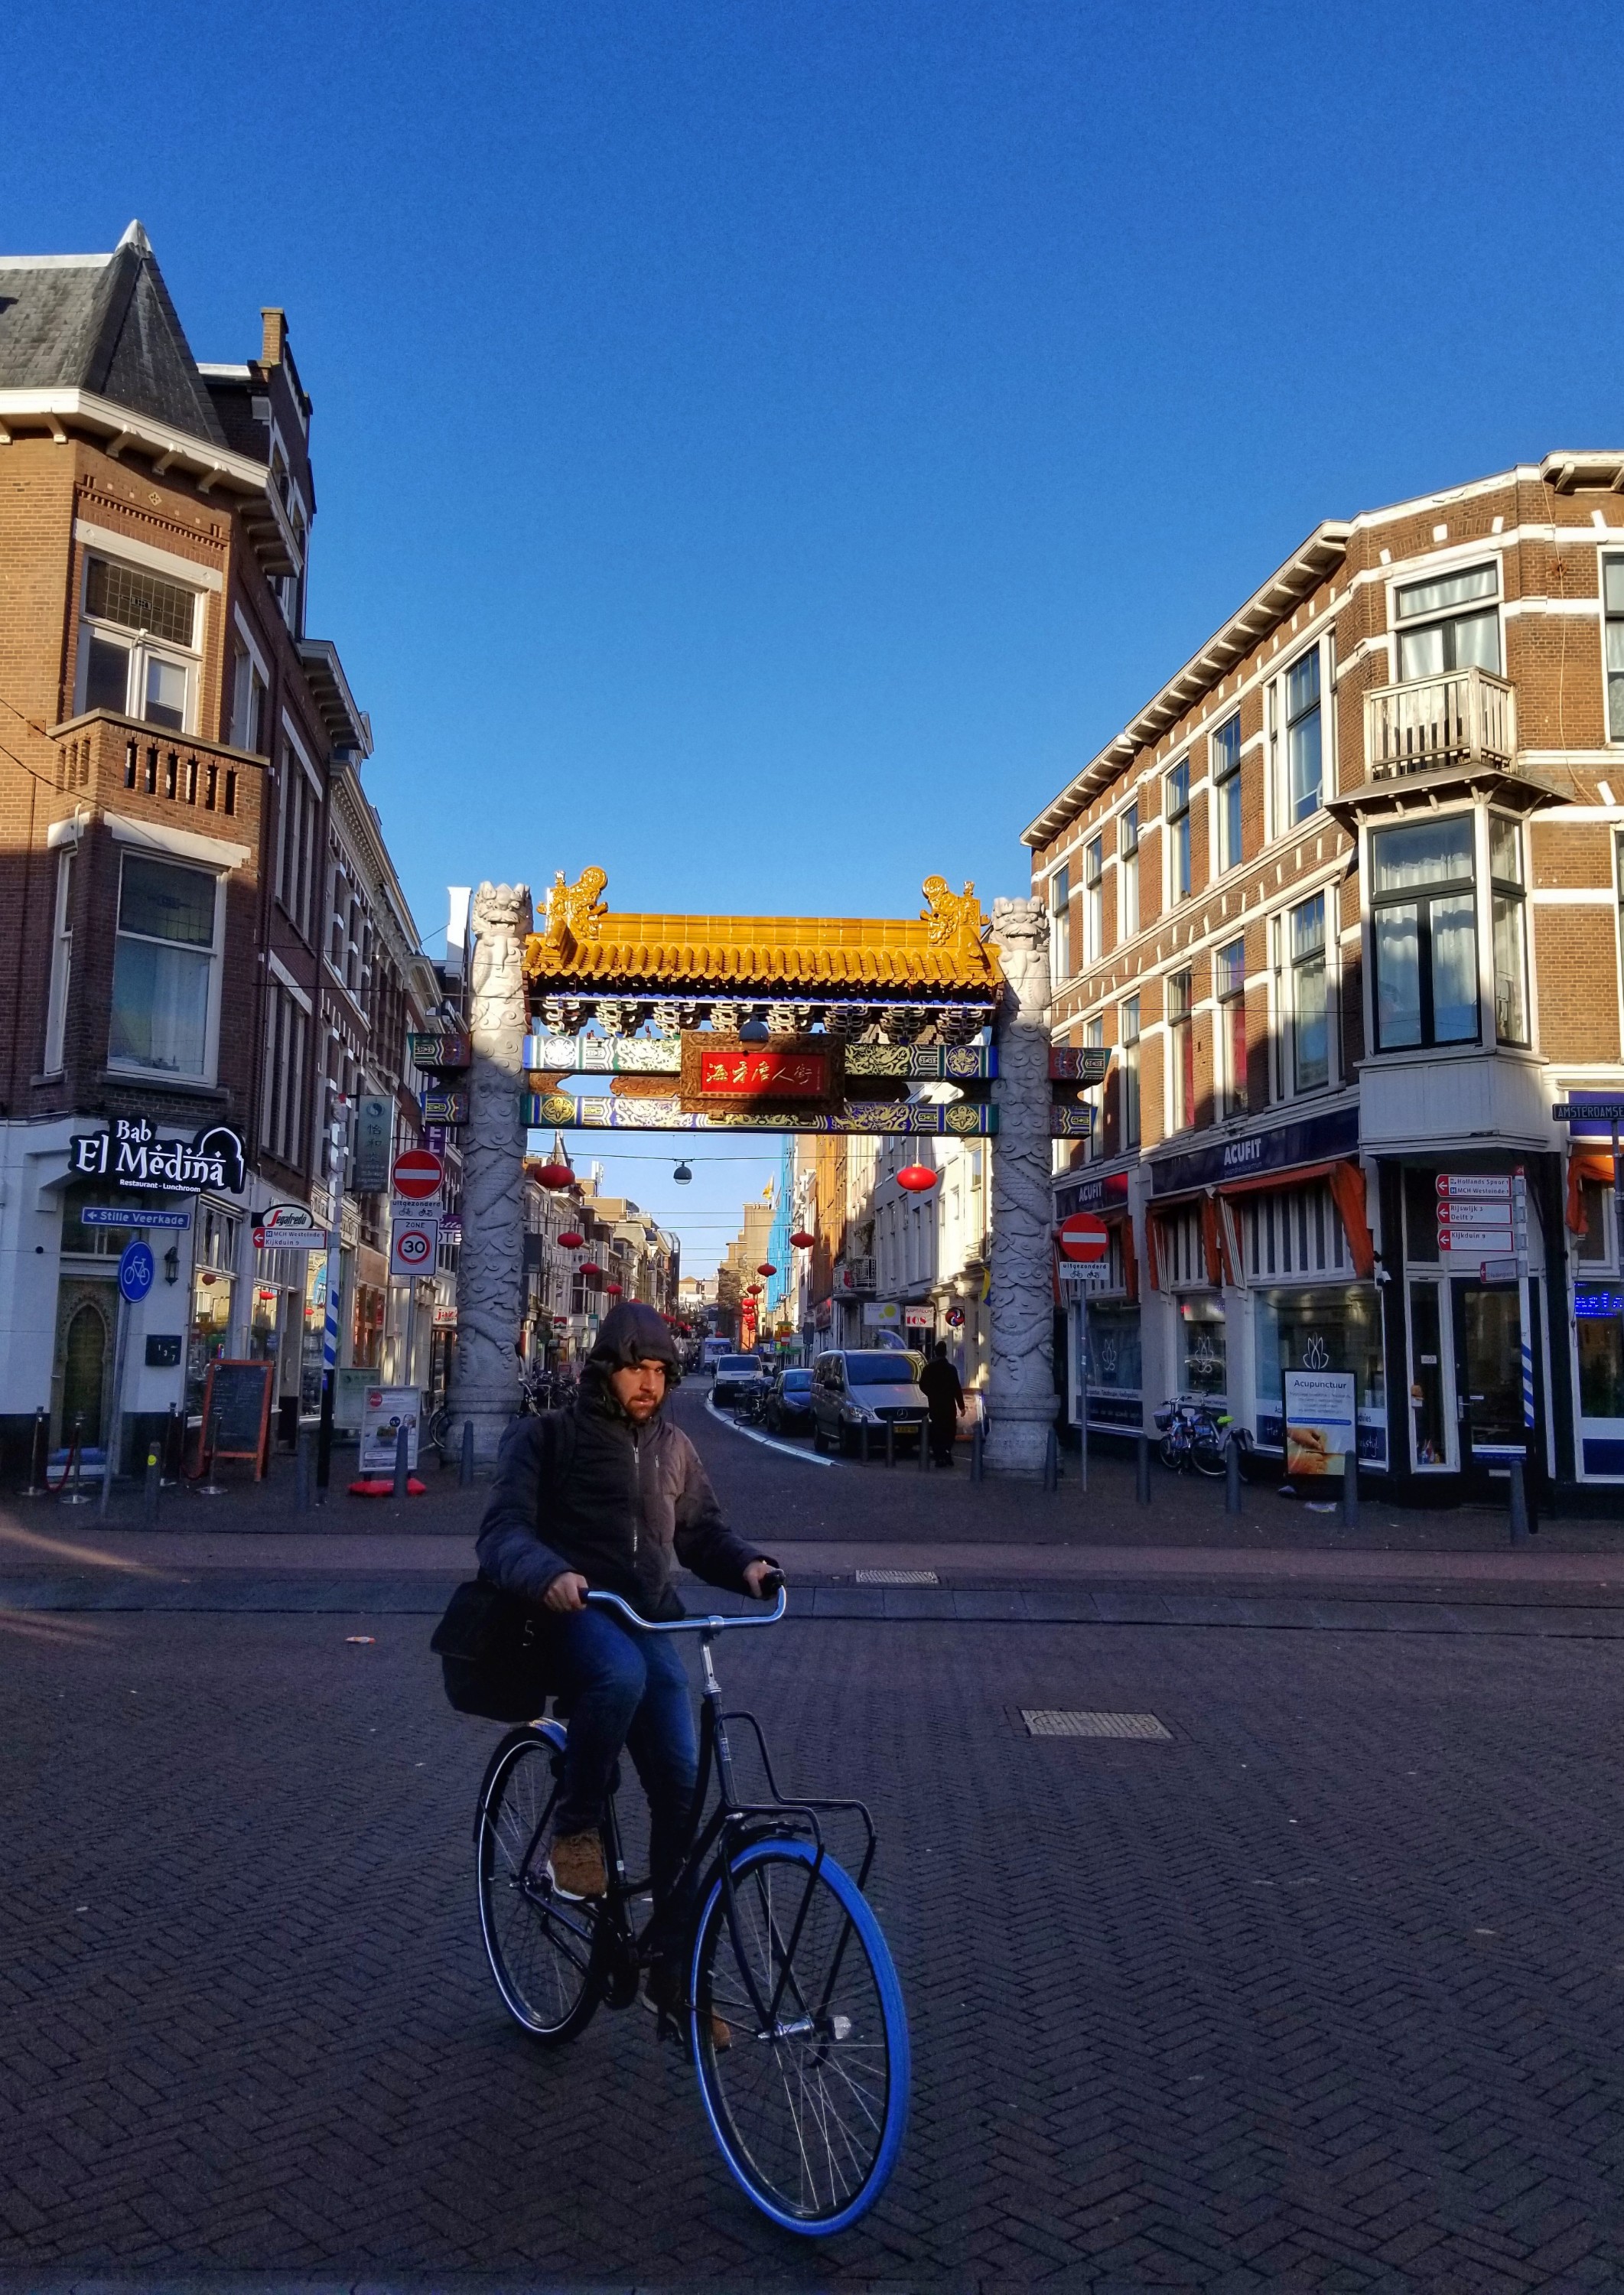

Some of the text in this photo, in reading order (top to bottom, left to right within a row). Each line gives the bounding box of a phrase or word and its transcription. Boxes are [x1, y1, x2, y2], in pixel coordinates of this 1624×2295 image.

[116, 1119, 151, 1143] Bab
[76, 1134, 109, 1174] El
[1224, 1138, 1261, 1166] ACUFIT
[119, 1179, 158, 1189] Restaurant
[163, 1183, 201, 1193] Lunchroom
[1079, 1182, 1102, 1203] ACUFIT
[99, 1212, 184, 1224] Stille Veerkade
[267, 1209, 307, 1227] Segafredo
[404, 1240, 426, 1254] 30
[1294, 1379, 1347, 1389] Acupunctuur
